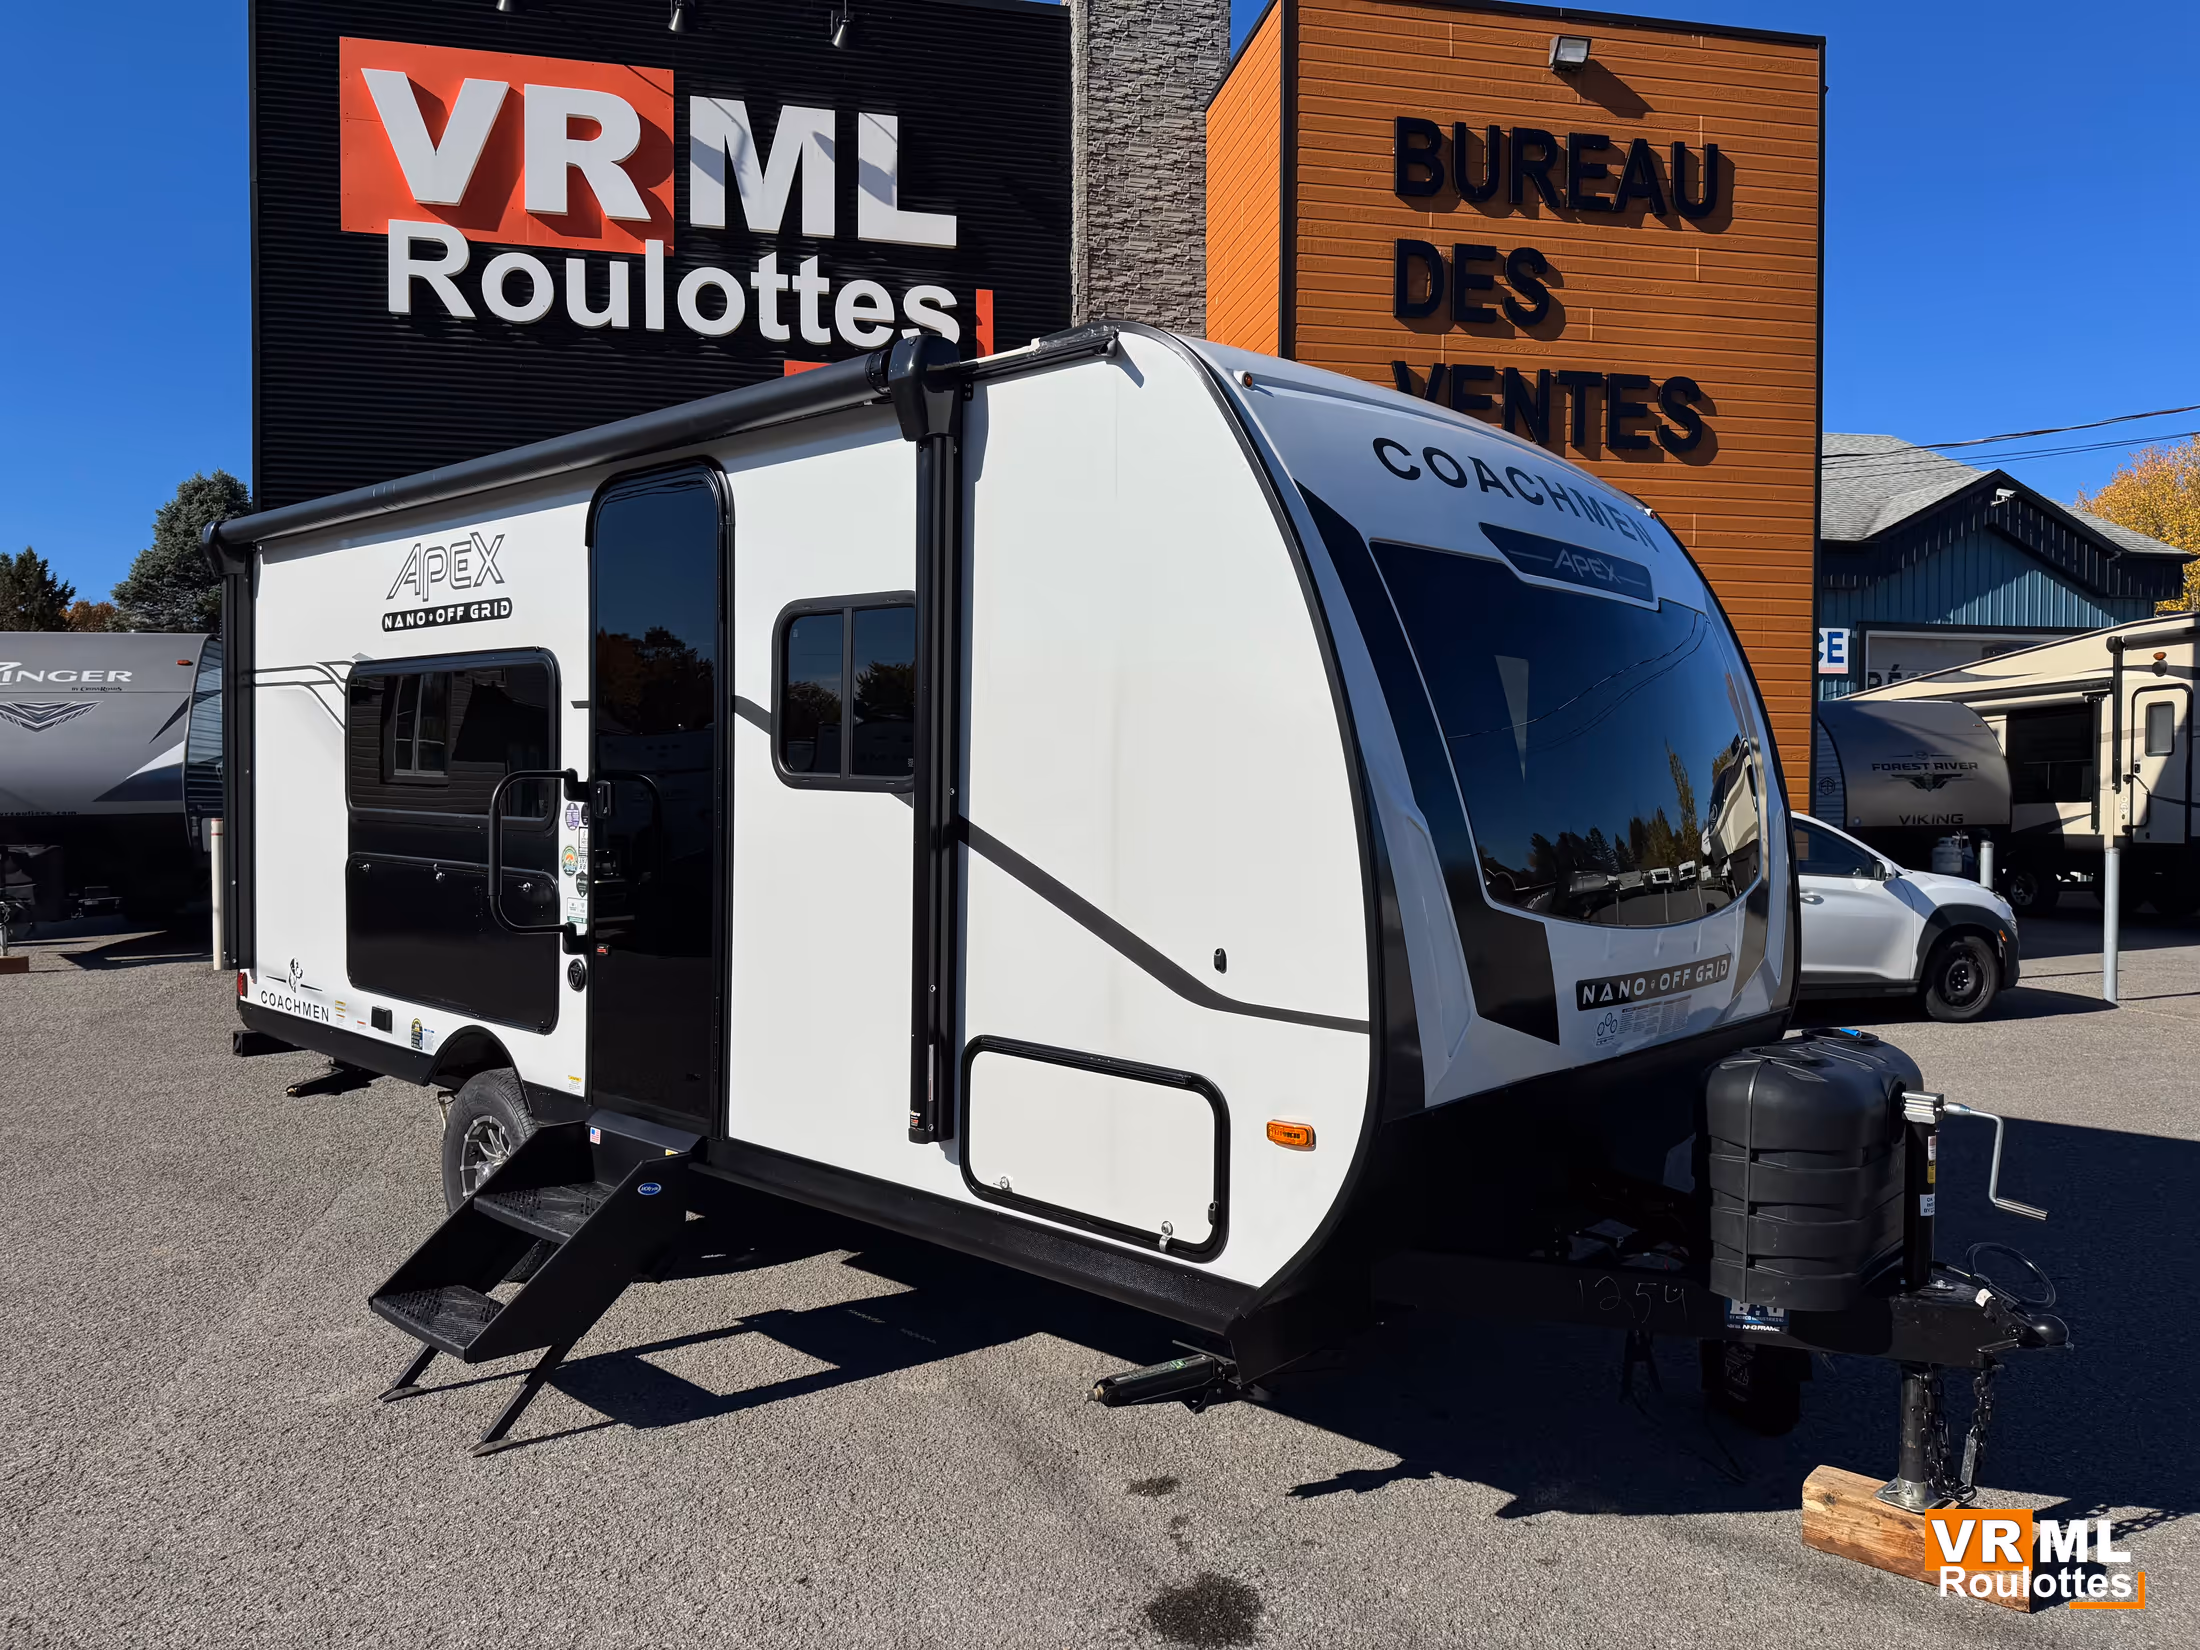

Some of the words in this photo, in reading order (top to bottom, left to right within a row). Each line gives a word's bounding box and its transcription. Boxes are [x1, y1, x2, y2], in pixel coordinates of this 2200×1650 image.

[361, 67, 652, 223] VR
[689, 95, 957, 249] ML
[1394, 115, 1718, 219] BUREAU
[387, 218, 961, 348] Roulottes
[1394, 237, 1550, 327] DES
[1372, 437, 1660, 553] COACHMEN
[384, 611, 426, 629] NANO
[435, 606, 465, 623] OFF
[469, 600, 510, 619] GRID
[1819, 631, 1845, 663] E
[1871, 763, 1929, 771] FOREST
[1934, 762, 1978, 770] RIVER
[1899, 813, 1964, 825] VIKING
[1582, 977, 1646, 1005] NANO
[1659, 968, 1690, 991] OFF
[1695, 958, 1728, 983] GRID
[260, 990, 330, 1023] COACHMEN
